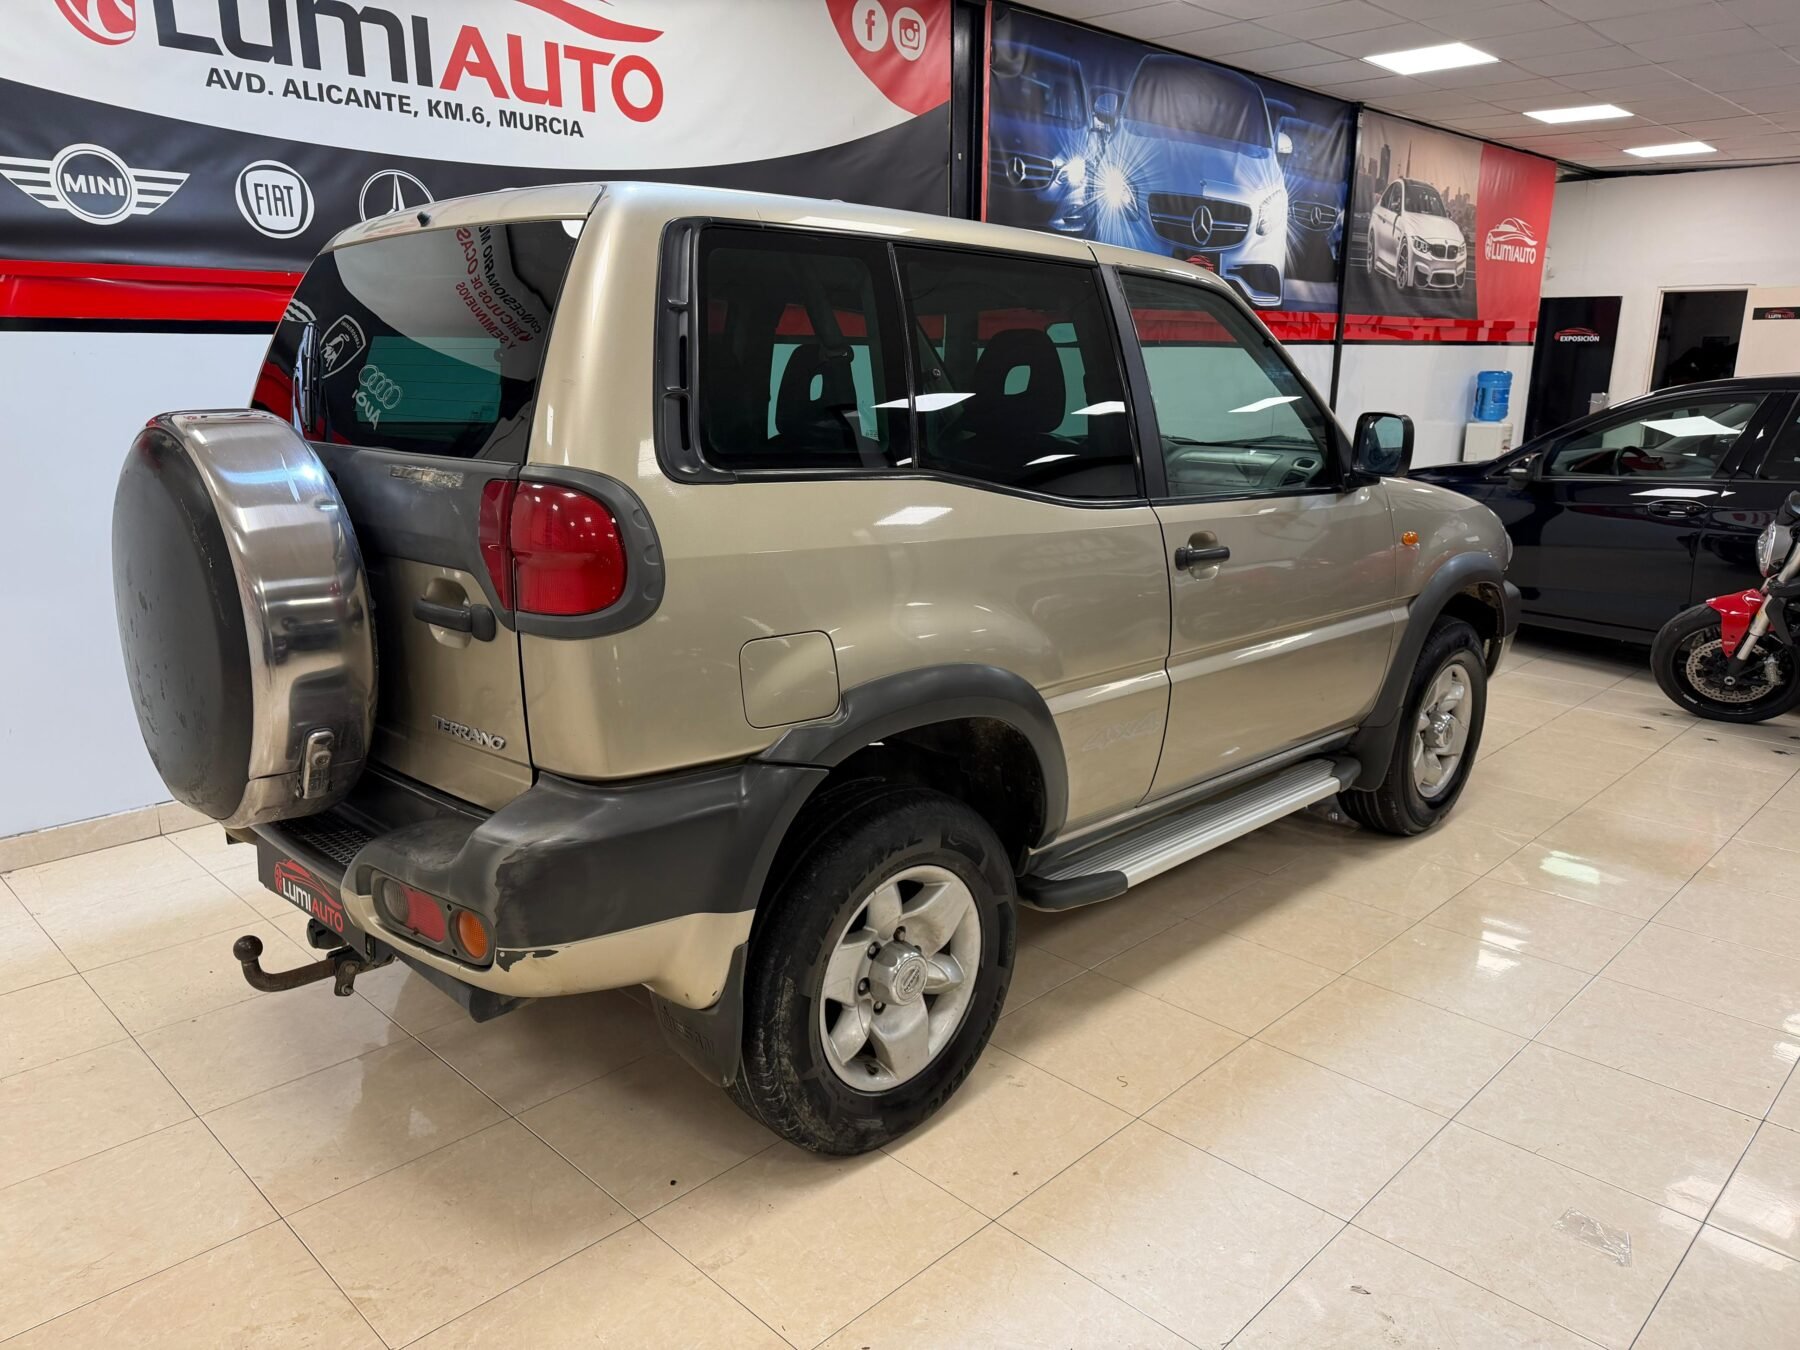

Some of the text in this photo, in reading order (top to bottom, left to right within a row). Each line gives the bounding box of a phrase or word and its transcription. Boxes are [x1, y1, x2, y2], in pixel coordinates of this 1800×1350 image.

[205, 67, 584, 138] AVD. ALICANTE, KM.6, MURCIA
[63, 172, 126, 197] MINI
[252, 182, 295, 218] FIAT
[432, 714, 506, 750] TERRANO
